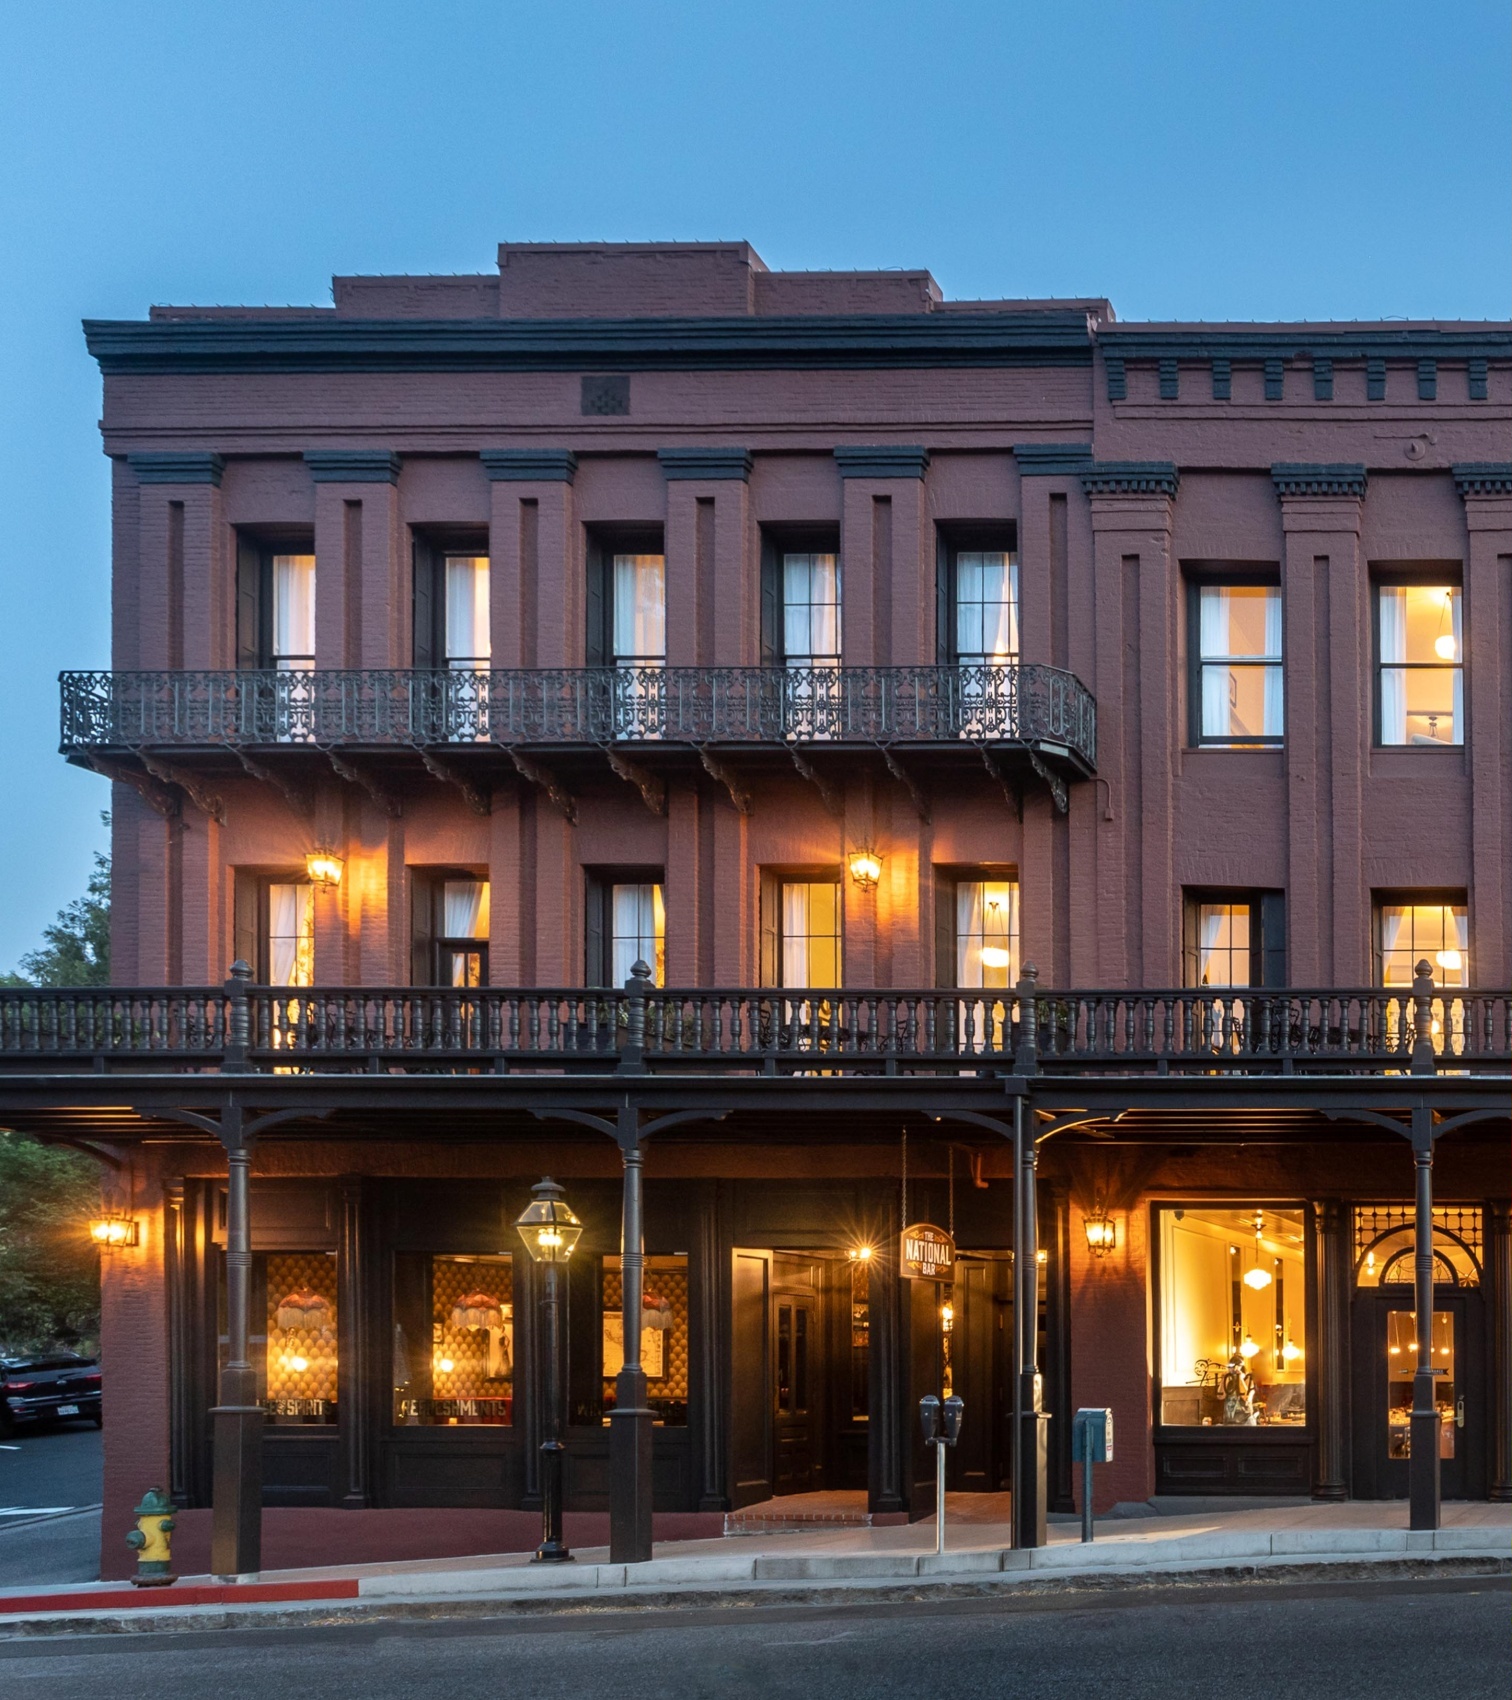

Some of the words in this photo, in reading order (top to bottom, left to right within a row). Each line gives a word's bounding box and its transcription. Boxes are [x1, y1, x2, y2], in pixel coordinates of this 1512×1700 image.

[924, 1231, 934, 1241] THE
[906, 1239, 951, 1266] NATIONAL
[922, 1262, 936, 1276] BAR
[401, 1399, 506, 1416] REFRESHMENTS
